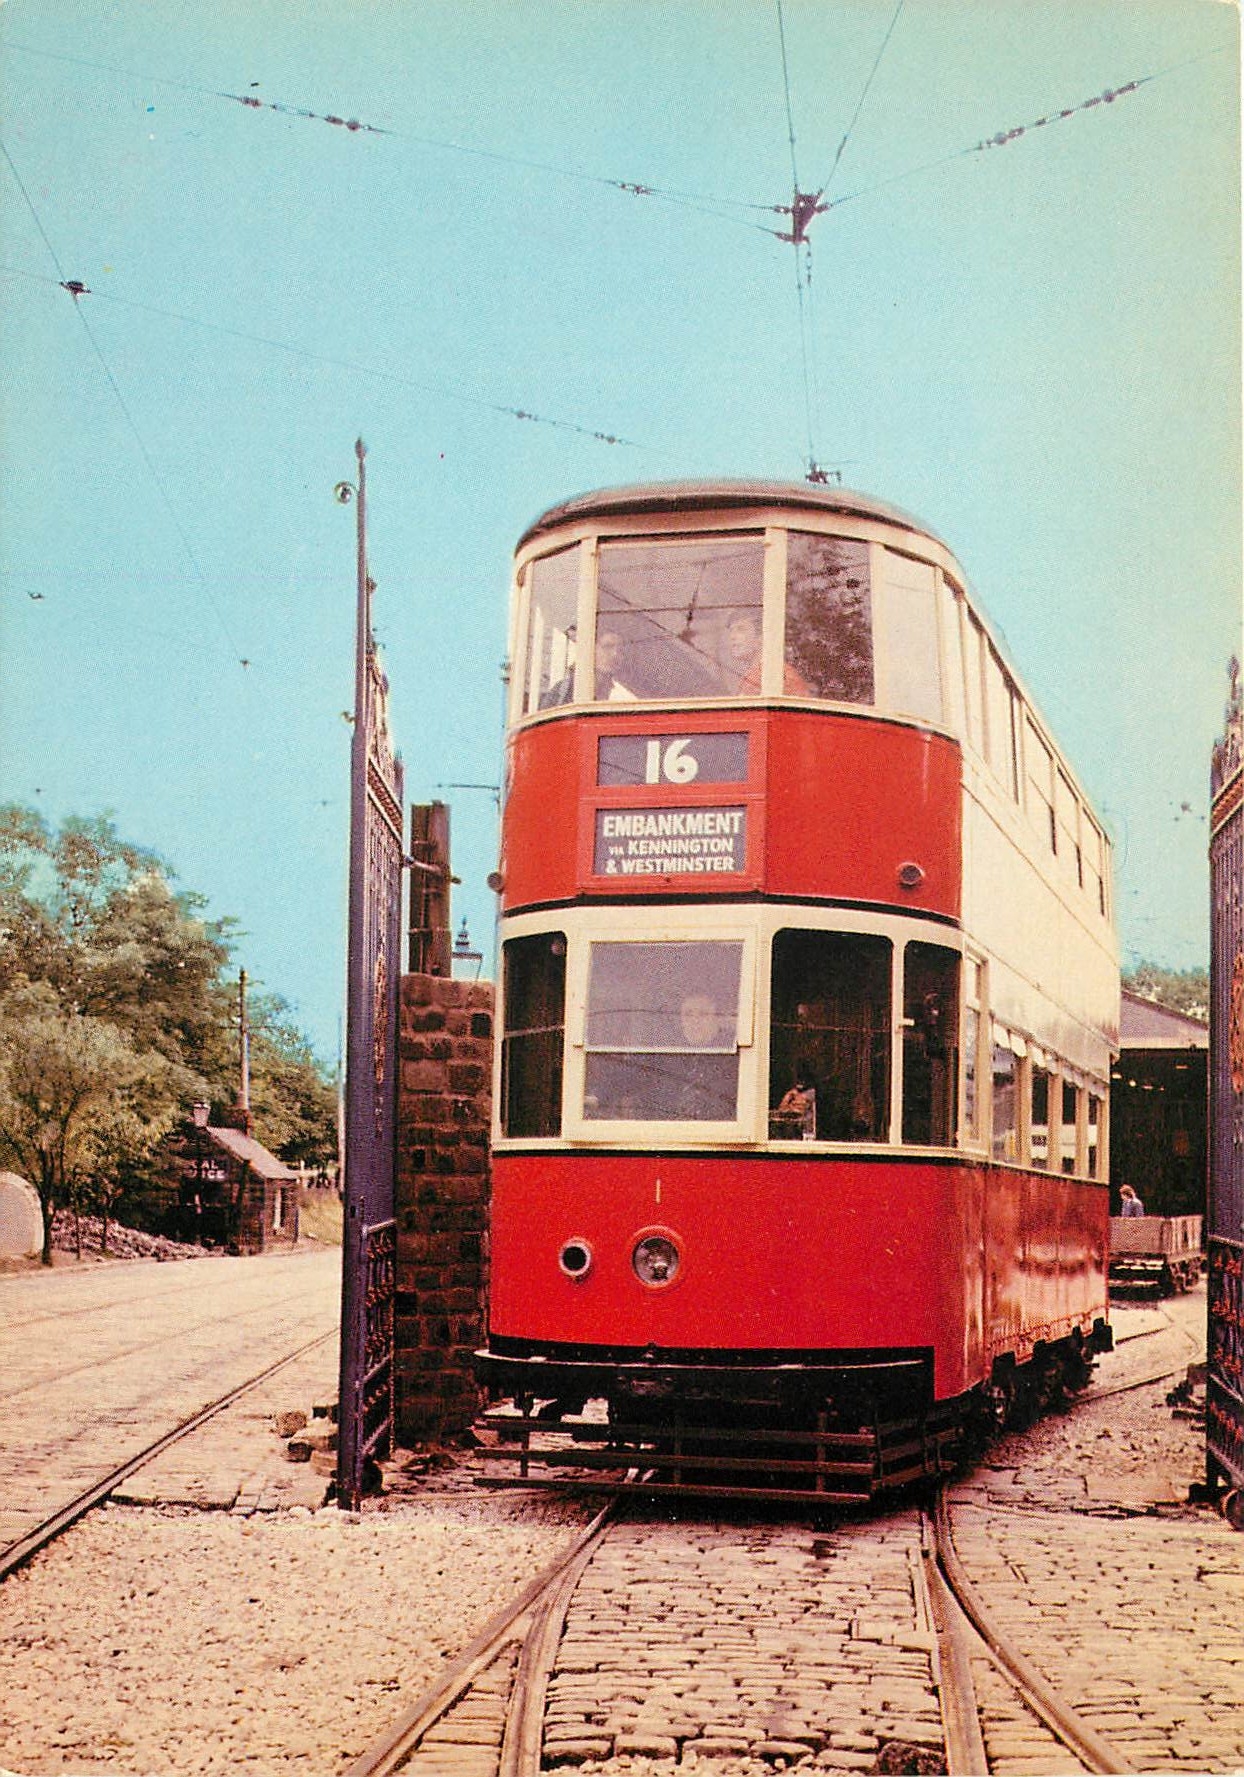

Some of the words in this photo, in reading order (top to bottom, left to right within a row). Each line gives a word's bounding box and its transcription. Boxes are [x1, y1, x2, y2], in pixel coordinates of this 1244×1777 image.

[645, 739, 699, 784] 16
[603, 812, 743, 837] EMBANKMENT
[627, 838, 734, 856] KENNINGTON
[606, 859, 617, 874] &
[621, 856, 735, 874] WESTMINSTER
